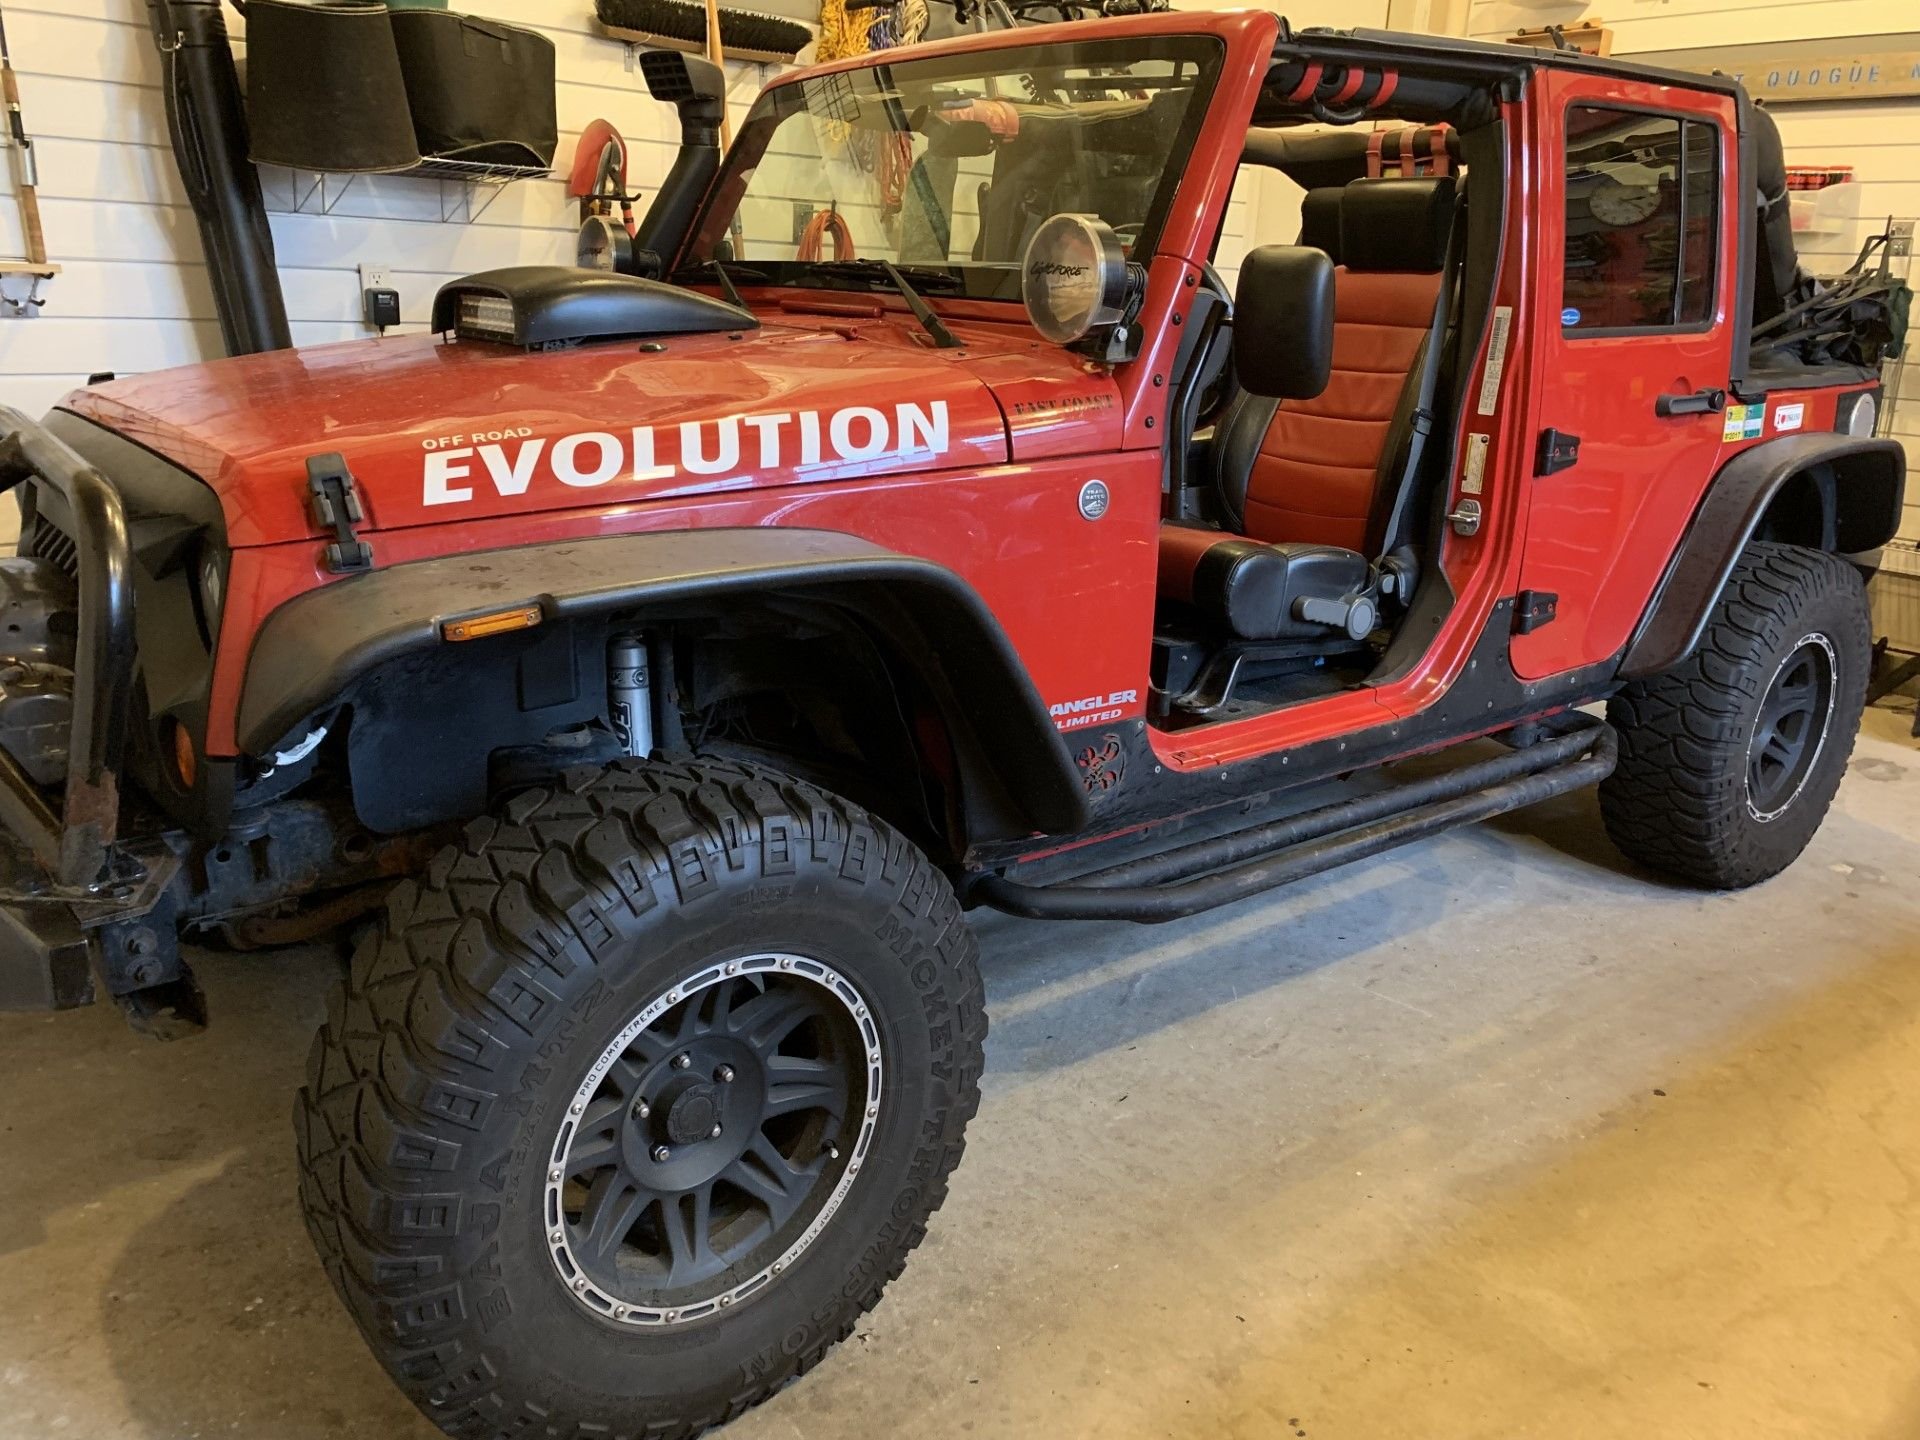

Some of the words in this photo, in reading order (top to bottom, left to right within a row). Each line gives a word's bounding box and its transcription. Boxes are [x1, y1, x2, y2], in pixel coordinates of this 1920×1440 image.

[1014, 400, 1057, 416] EAST
[1062, 394, 1113, 411] COAST
[422, 434, 464, 450] OFF
[471, 427, 533, 444] ROAD
[422, 400, 949, 507] EVOLUTION
[1049, 690, 1137, 717] ANGLER
[1056, 709, 1122, 729] LIMITED
[874, 912, 953, 1082] MICKEY
[579, 1074, 597, 1097] PRO
[595, 1041, 620, 1072] COMP
[620, 1002, 663, 1041] XTREME
[471, 1148, 513, 1334] BAJA
[504, 977, 615, 1119] MTZ
[837, 1179, 852, 1198] PRO
[820, 1199, 839, 1228] COMP
[739, 1109, 947, 1387] THOMPSON
[786, 1227, 820, 1264] XTREME
